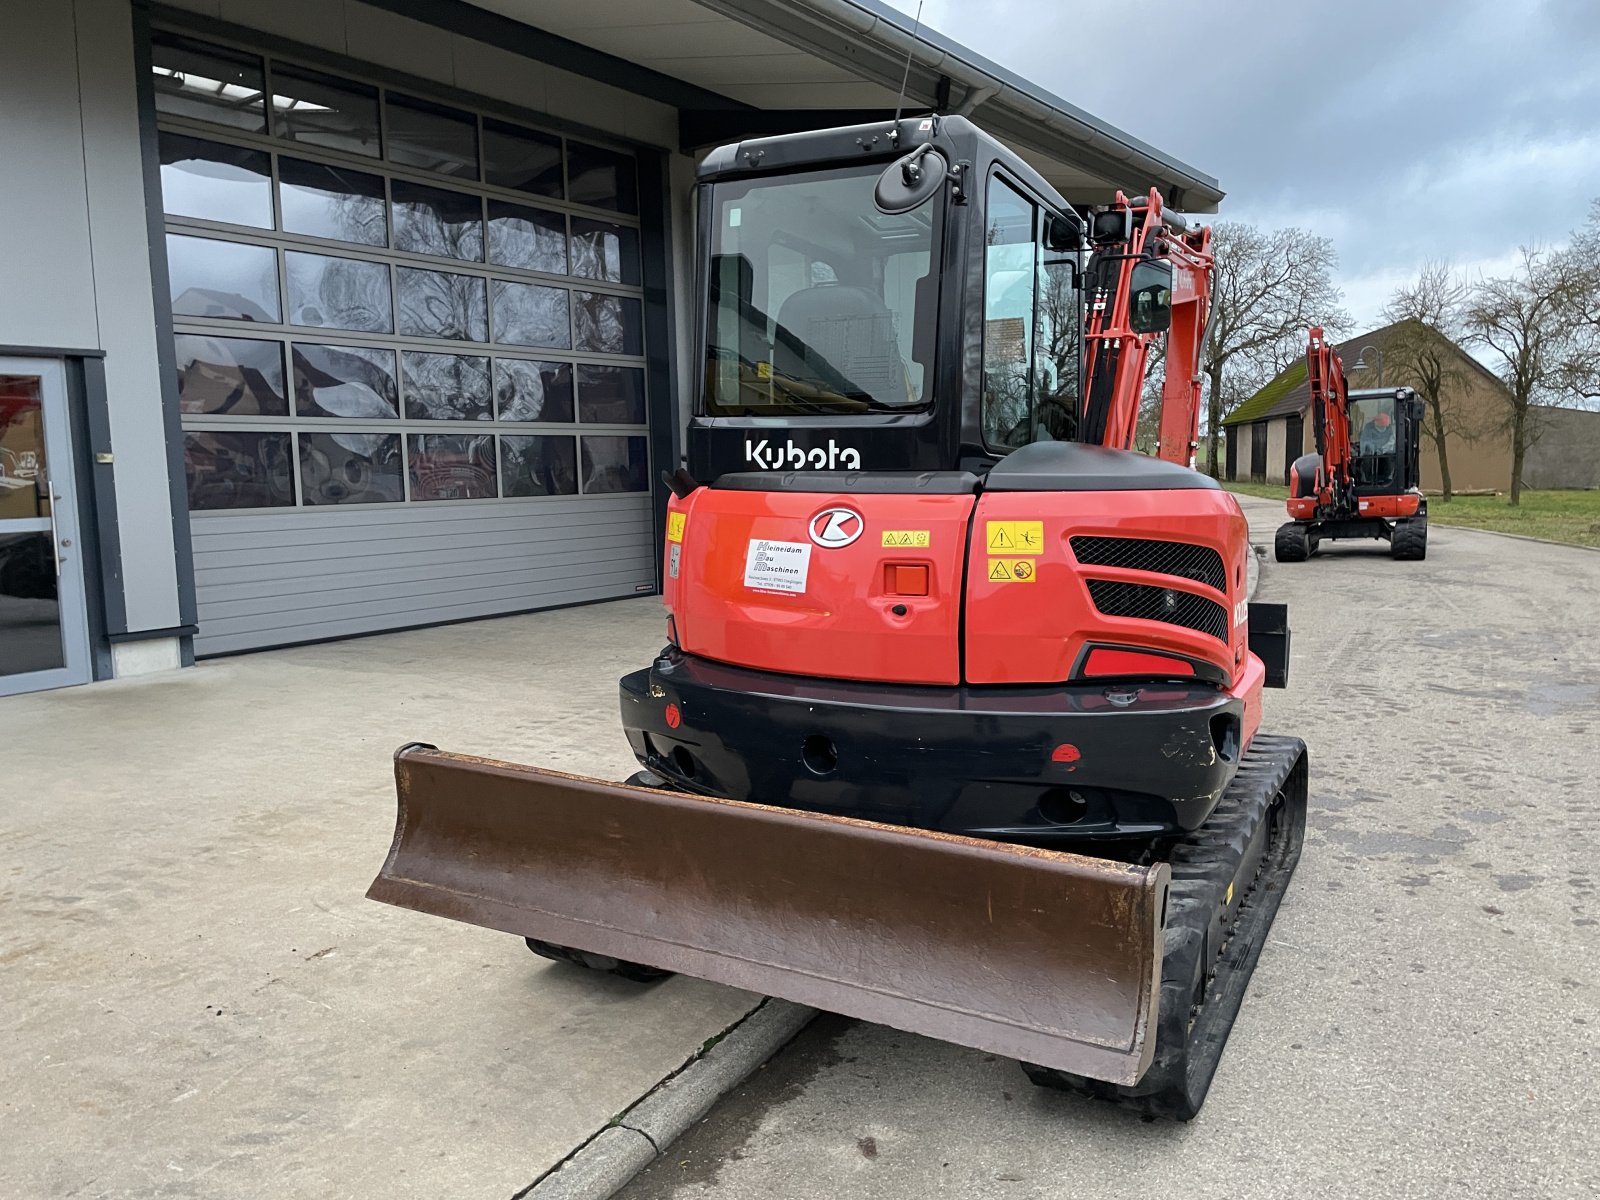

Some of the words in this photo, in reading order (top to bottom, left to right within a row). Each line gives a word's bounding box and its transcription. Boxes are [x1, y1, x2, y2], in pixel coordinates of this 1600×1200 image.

[745, 439, 861, 470] Kubota
[757, 542, 802, 553] Kleineidam
[755, 552, 774, 561] Bau
[754, 562, 799, 574] Maschinen
